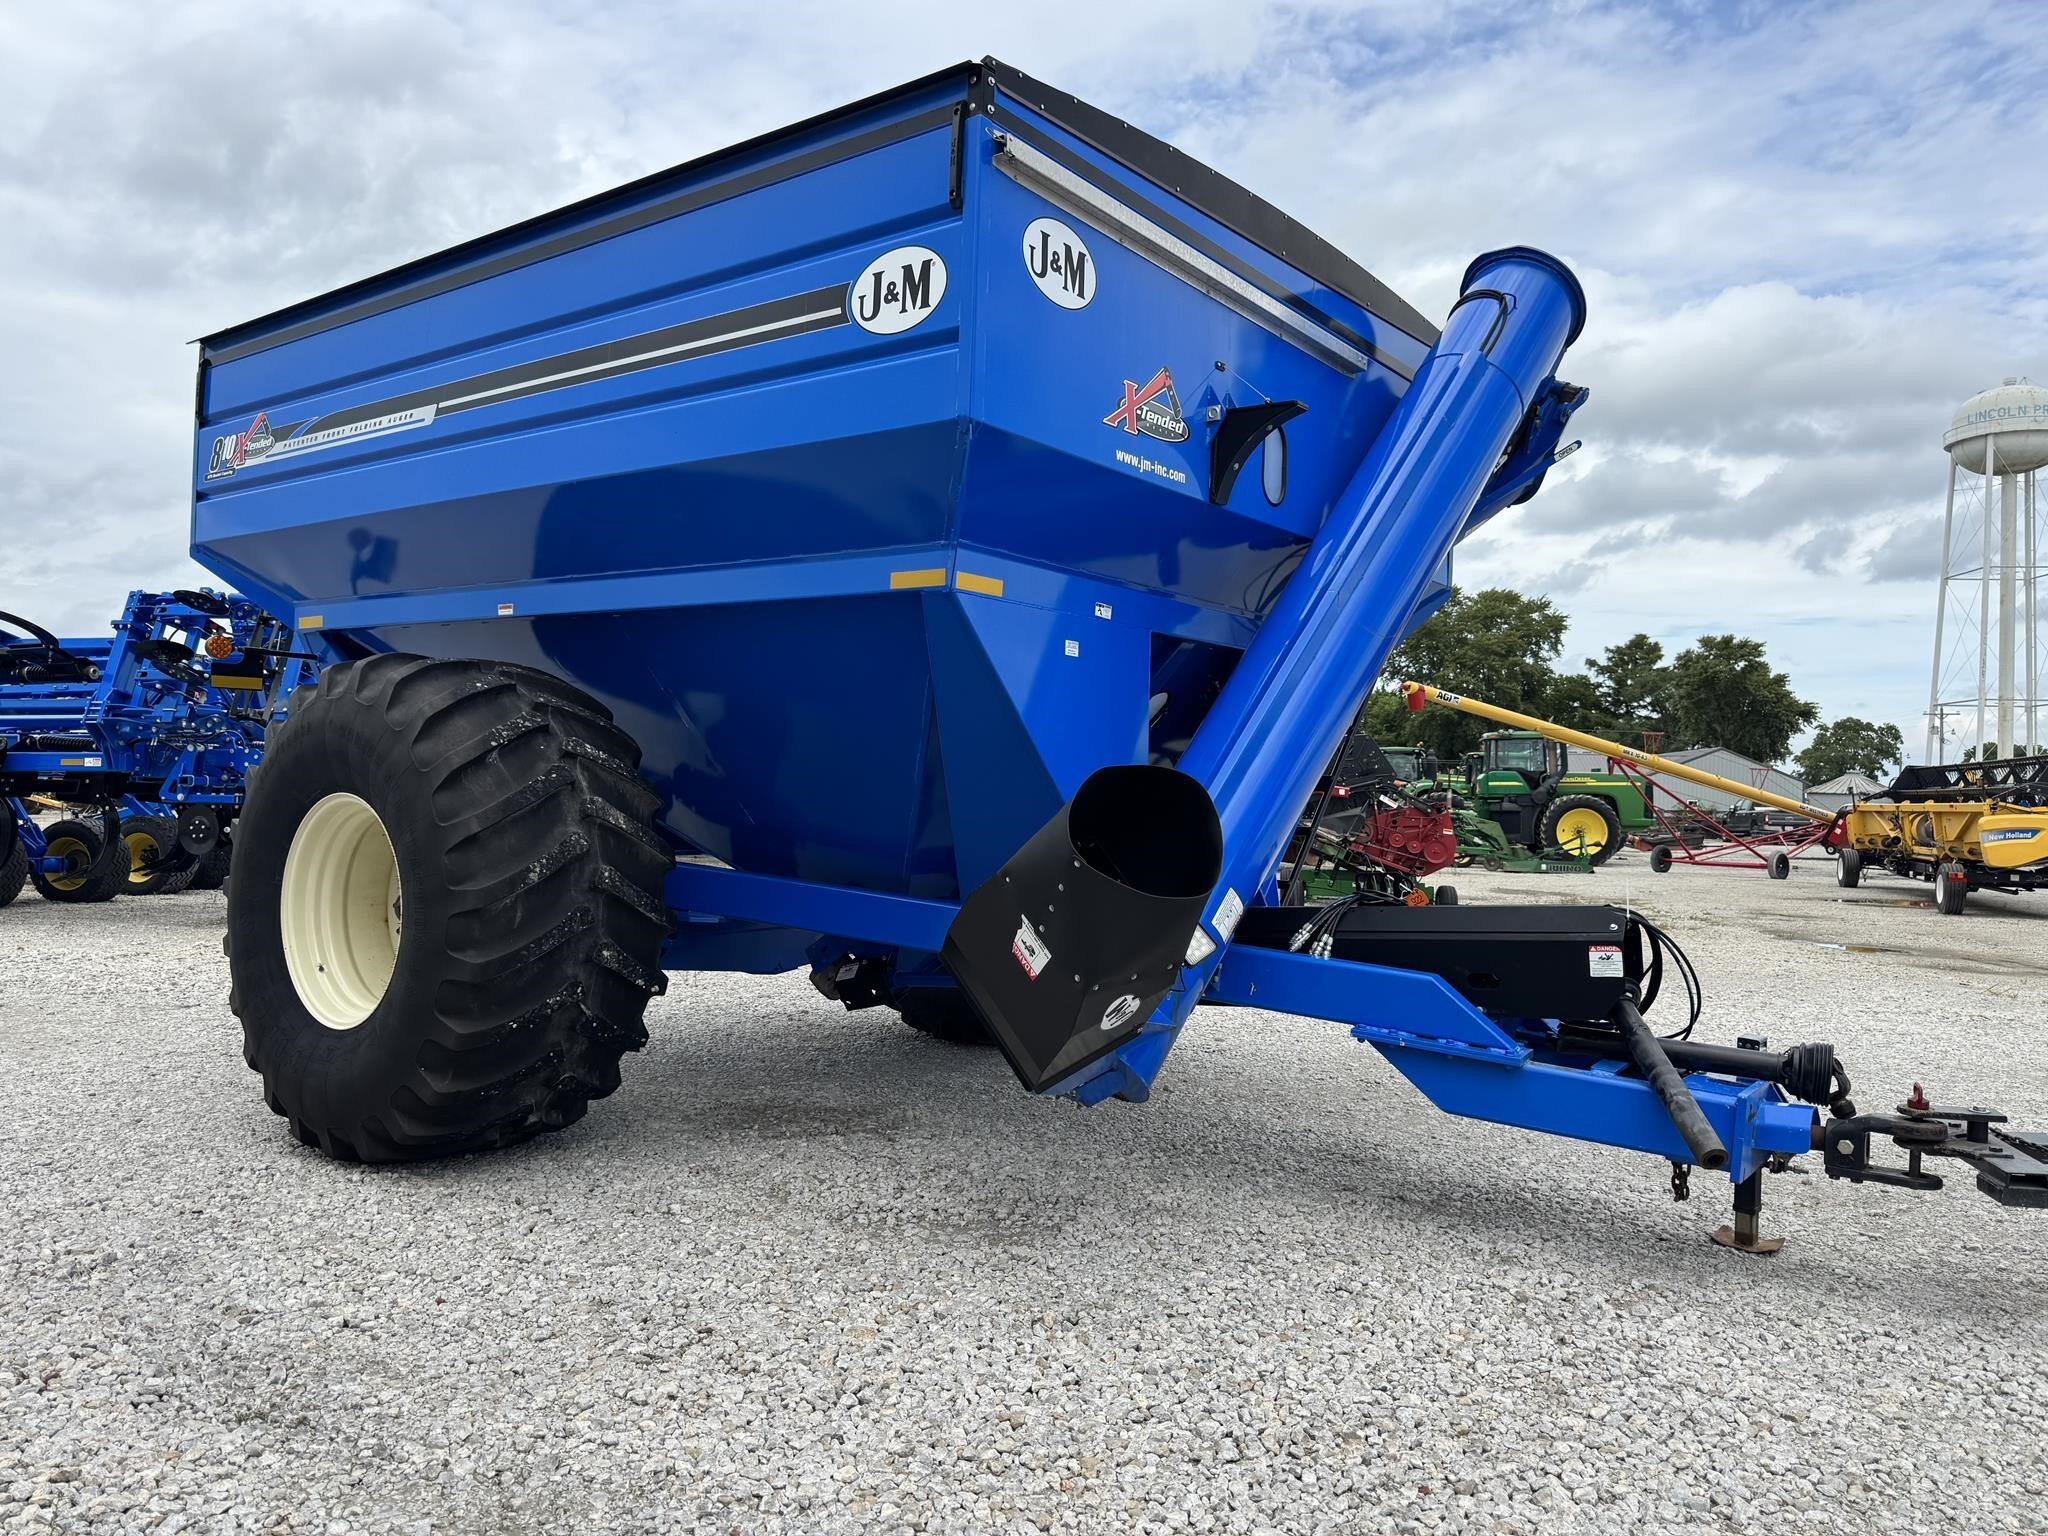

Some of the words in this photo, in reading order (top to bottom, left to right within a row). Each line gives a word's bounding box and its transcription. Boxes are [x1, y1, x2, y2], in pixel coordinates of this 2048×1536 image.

[1028, 230, 1088, 300] J&M
[858, 258, 934, 322] J&M
[1967, 405, 2027, 424] LINCOLN
[209, 434, 237, 473] 810
[1116, 449, 1186, 484] www.jm-inc.com
[1558, 446, 1573, 458] OPEN
